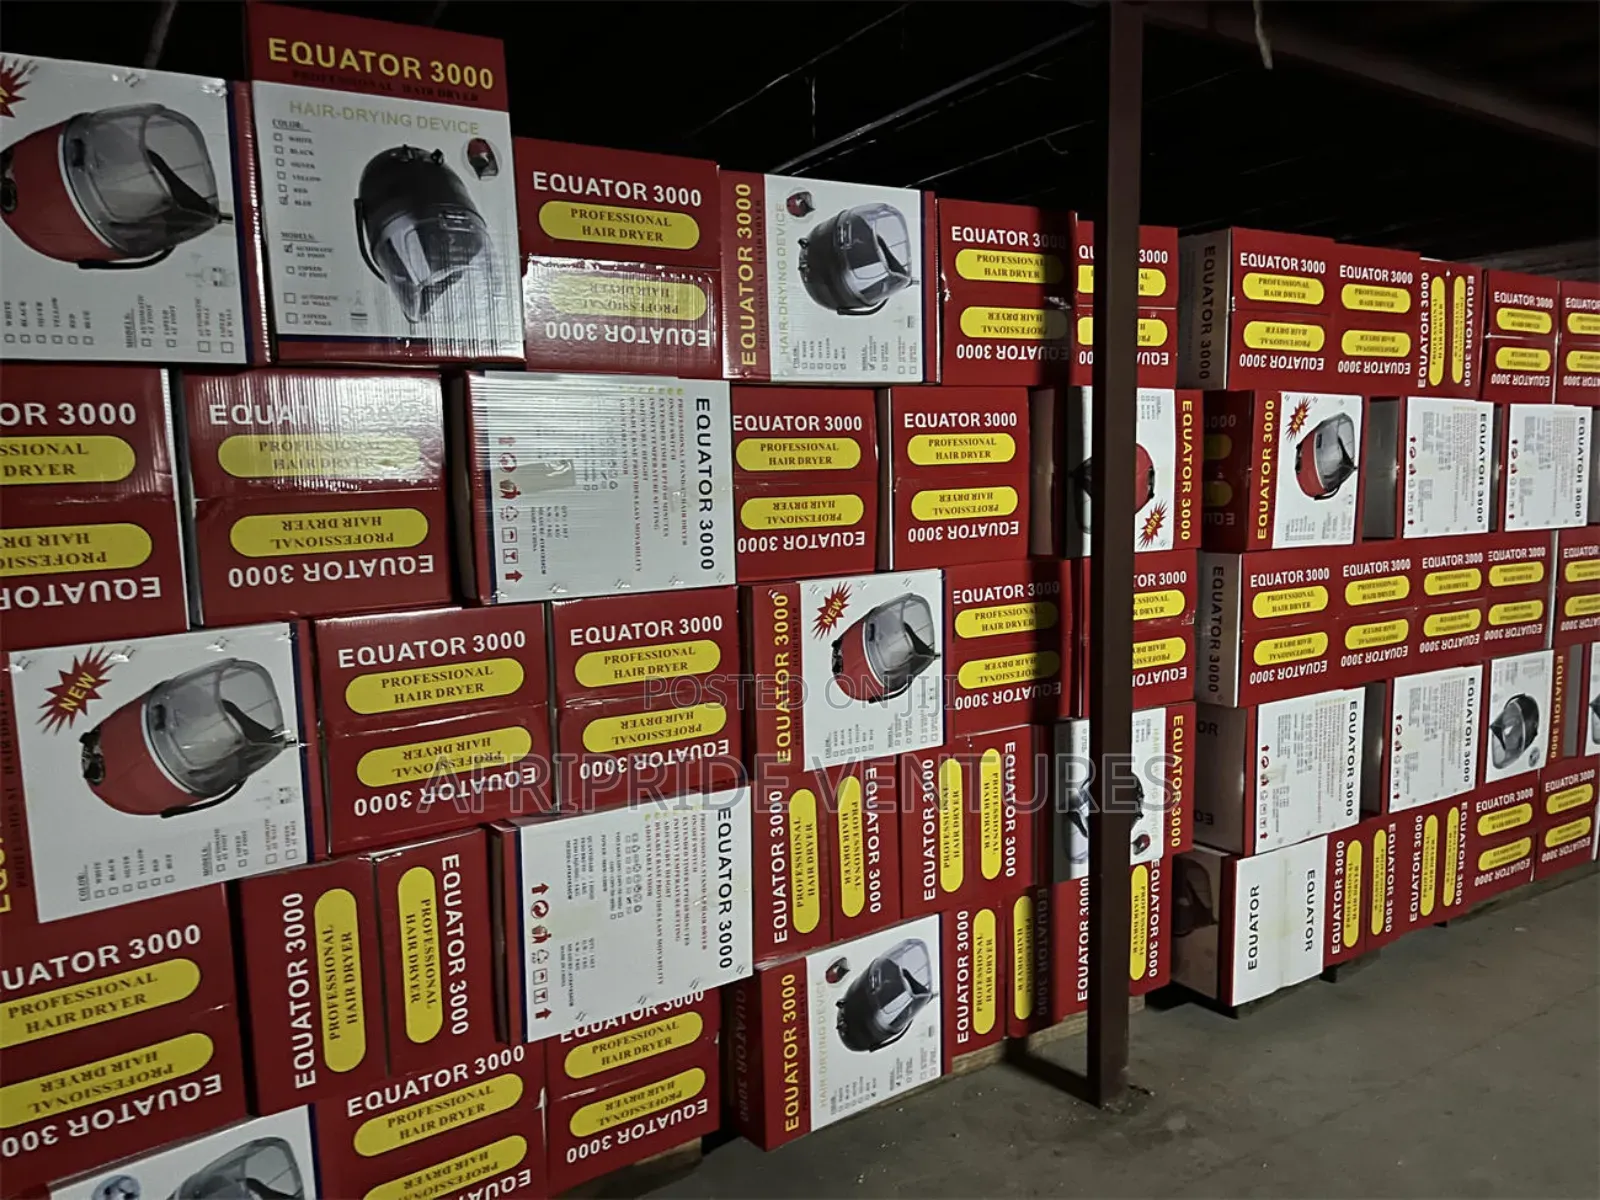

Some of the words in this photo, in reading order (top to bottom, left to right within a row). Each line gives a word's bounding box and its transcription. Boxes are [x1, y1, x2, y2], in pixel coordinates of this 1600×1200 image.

[268, 37, 422, 80] EQUATOR
[430, 61, 494, 90] 3000
[289, 100, 412, 128] HAIR-DRYING
[416, 116, 479, 135] DEVICE
[532, 171, 646, 200] EQUATOR
[653, 186, 702, 207] 3000
[570, 208, 672, 228] PROFESSIONAL
[735, 184, 752, 238] 3000
[581, 225, 616, 238] HAIR
[619, 229, 663, 242] DRYER
[775, 203, 787, 257] DEVICE
[951, 226, 1028, 248] EQUATOR
[984, 267, 1007, 276] HAIR
[1240, 252, 1299, 272] EQUATOR
[1301, 259, 1327, 274] 3000
[1340, 265, 1389, 282] EQUATOR
[1390, 269, 1413, 284] 3000
[737, 246, 757, 366] EQUATOR
[1201, 246, 1216, 335] EQUATOR
[1420, 272, 1430, 316] 3000
[777, 260, 789, 355] HAIR-DRYING
[545, 322, 598, 340] 3000
[604, 324, 711, 347] EQUATOR
[956, 343, 992, 359] 3000
[1199, 339, 1212, 380] 3000
[1239, 354, 1267, 367] 3000
[1271, 357, 1324, 371] EQUATOR
[1338, 360, 1361, 373] 3000
[1418, 318, 1430, 388] EQUATOR
[1363, 361, 1412, 374] EQUATOR
[58, 402, 137, 426] 3000
[733, 415, 820, 432] EQUATOR
[824, 416, 862, 431] 3000
[904, 412, 980, 428] EQUATOR
[984, 412, 1018, 427] 3000
[1262, 400, 1275, 441] 3000
[696, 398, 713, 512] EQUATOR
[760, 442, 839, 453] PROFESSIONAL
[769, 457, 796, 466] HAIR
[936, 452, 959, 461] HAIR
[961, 451, 992, 460] DRYER
[1181, 401, 1193, 492] EQUATOR
[4, 465, 77, 478] DRYER
[808, 500, 836, 509] HAIR
[1257, 449, 1273, 539] EQUATOR
[907, 526, 943, 542] 3000
[945, 521, 1019, 541] EQUATOR
[1146, 512, 1161, 536] NEW
[1181, 499, 1192, 540] 3000
[39, 533, 91, 549] HAIR
[270, 532, 394, 550] PROFESSIONAL
[699, 519, 715, 570] 3000
[737, 537, 778, 553] 3000
[783, 531, 865, 551] EQUATOR
[228, 564, 294, 588] 3000
[302, 555, 435, 582] EQUATOR
[1159, 571, 1187, 585] 3000
[1250, 570, 1304, 588] EQUATOR
[1306, 567, 1330, 581] 3000
[1343, 561, 1389, 578] EQUATOR
[1391, 558, 1411, 572] 3000
[1422, 555, 1463, 569] EQUATOR
[953, 584, 1024, 604] EQUATOR
[1210, 566, 1224, 650] EQUATOR
[822, 597, 843, 627] NEW
[570, 620, 674, 646] EQUATOR
[679, 615, 723, 635] 3000
[338, 637, 466, 668] EQUATOR
[473, 630, 526, 653] 3000
[604, 647, 696, 666] PROFESSIONAL
[1341, 653, 1363, 668] 3000
[1364, 645, 1408, 663] EQUATOR
[381, 665, 493, 689] PROFESSIONAL
[1208, 655, 1220, 693] 3000
[1249, 670, 1274, 684] 3000
[1274, 660, 1328, 681] EQUATOR
[60, 672, 97, 712] NEW
[580, 757, 628, 779] 3000
[634, 740, 729, 770] EQUATOR
[1170, 715, 1184, 804] EQUATOR
[420, 767, 536, 805] EQUATOR
[922, 759, 934, 808] 3000
[1005, 742, 1016, 832] EQUATOR
[1545, 775, 1579, 793] EQUATOR
[354, 790, 413, 816] 3000
[769, 790, 784, 838] 3000
[864, 768, 881, 864] EQUATOR
[1476, 795, 1516, 813] EQUATOR
[1516, 787, 1534, 802] 3000
[806, 823, 814, 860] DRYER
[1170, 808, 1181, 848] 3000
[718, 807, 733, 915] EQUATOR
[923, 814, 936, 900] EQUATOR
[1005, 837, 1016, 877] 3000
[1335, 841, 1345, 870] 3000
[771, 842, 788, 943] EQUATOR
[806, 863, 815, 897] HAIR
[868, 870, 881, 913] 3000
[282, 893, 307, 953] 3000
[441, 854, 466, 976] EQUATOR
[1305, 869, 1315, 952] EQUATOR
[1331, 872, 1343, 955] EQUATOR
[128, 924, 201, 960] 3000
[1249, 885, 1260, 970] EQUATOR
[718, 920, 733, 969] 3000
[7, 972, 158, 1020] PROFESSIONAL
[81, 992, 147, 1020] DRYER
[449, 980, 470, 1035] 3000
[781, 974, 796, 1024] 3000
[26, 1012, 77, 1034] HAIR
[287, 958, 316, 1089] EQUATOR
[592, 1022, 680, 1054] PROFESSIONAL
[28, 1063, 174, 1114] PROFESSIONAL
[40, 1061, 106, 1093] DRYER
[347, 1063, 468, 1118] EQUATOR
[474, 1045, 526, 1076] 3000
[782, 1027, 800, 1132] EQUATOR
[67, 1074, 222, 1138] EQUATOR
[387, 1085, 494, 1129] PROFESSIONAL
[616, 1099, 708, 1143] EQUATOR
[566, 1135, 612, 1163] 3000
